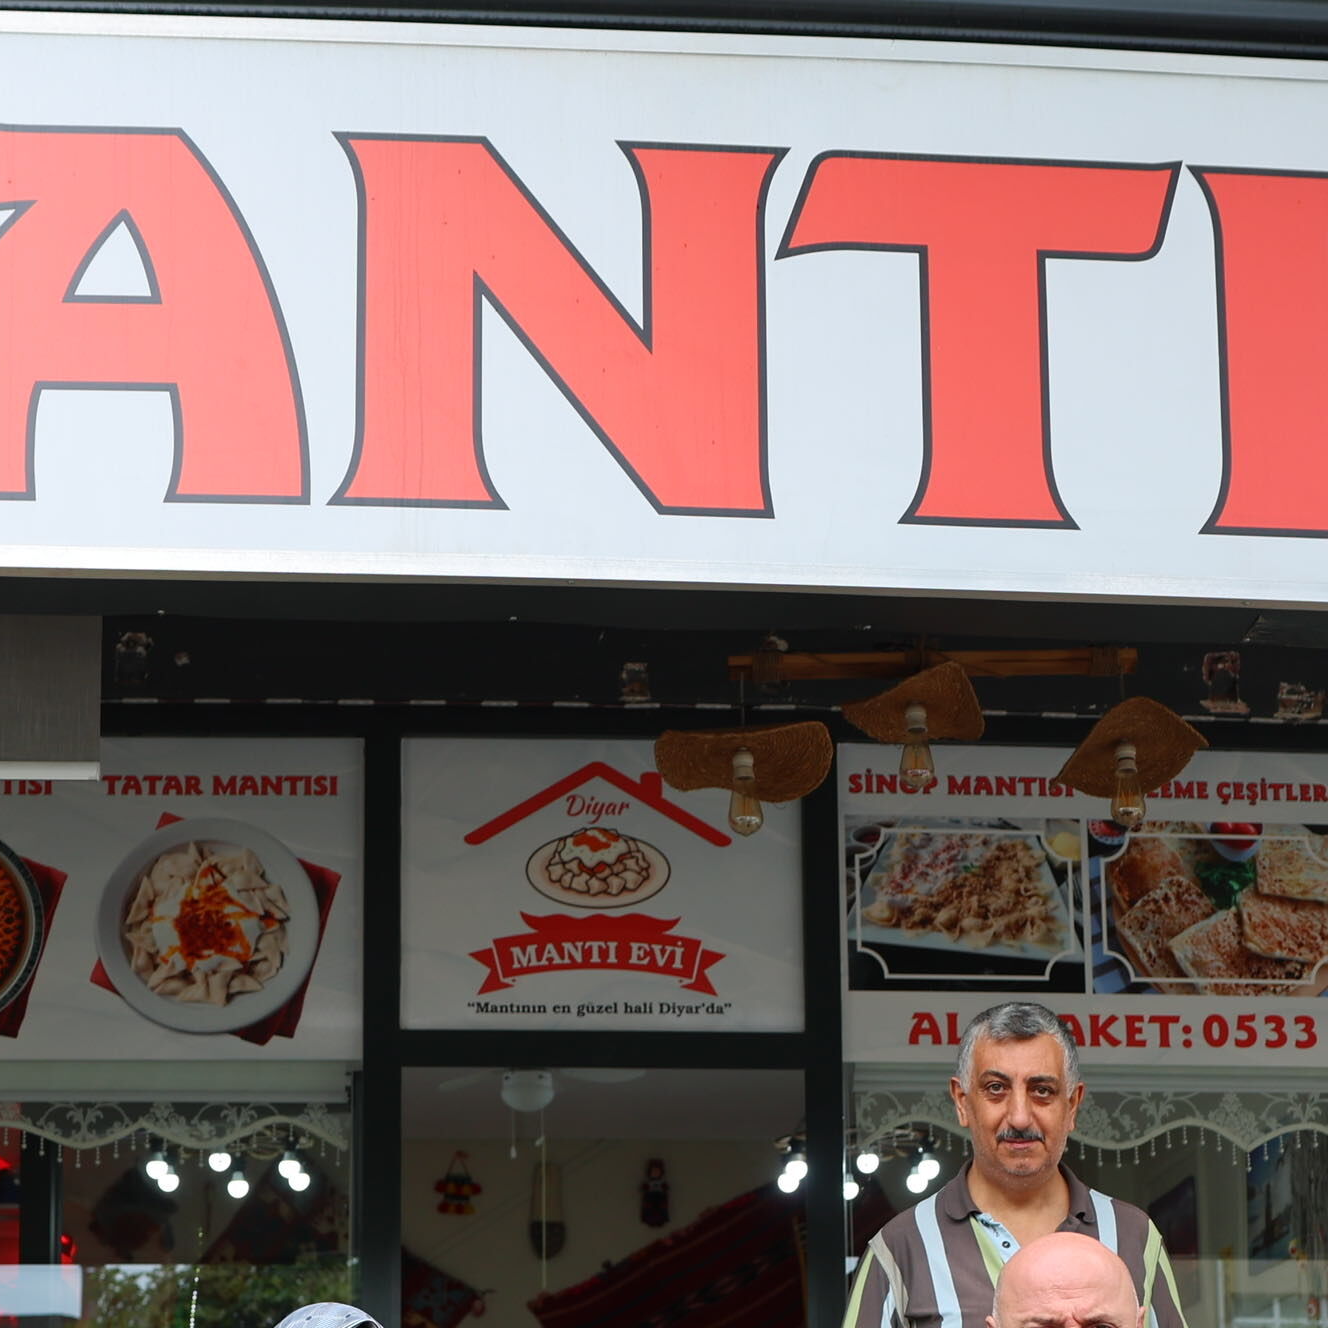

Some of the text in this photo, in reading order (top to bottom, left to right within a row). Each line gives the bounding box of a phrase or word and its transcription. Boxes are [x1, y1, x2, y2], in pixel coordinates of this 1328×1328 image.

[101, 775, 338, 796] TATAR MANTISI
[565, 794, 630, 824] Diyar
[510, 940, 684, 969] MANTI EVİ
[552, 1004, 571, 1015] en
[577, 1002, 618, 1017] güzel
[623, 1001, 653, 1015] hali
[909, 1012, 961, 1046] AL
